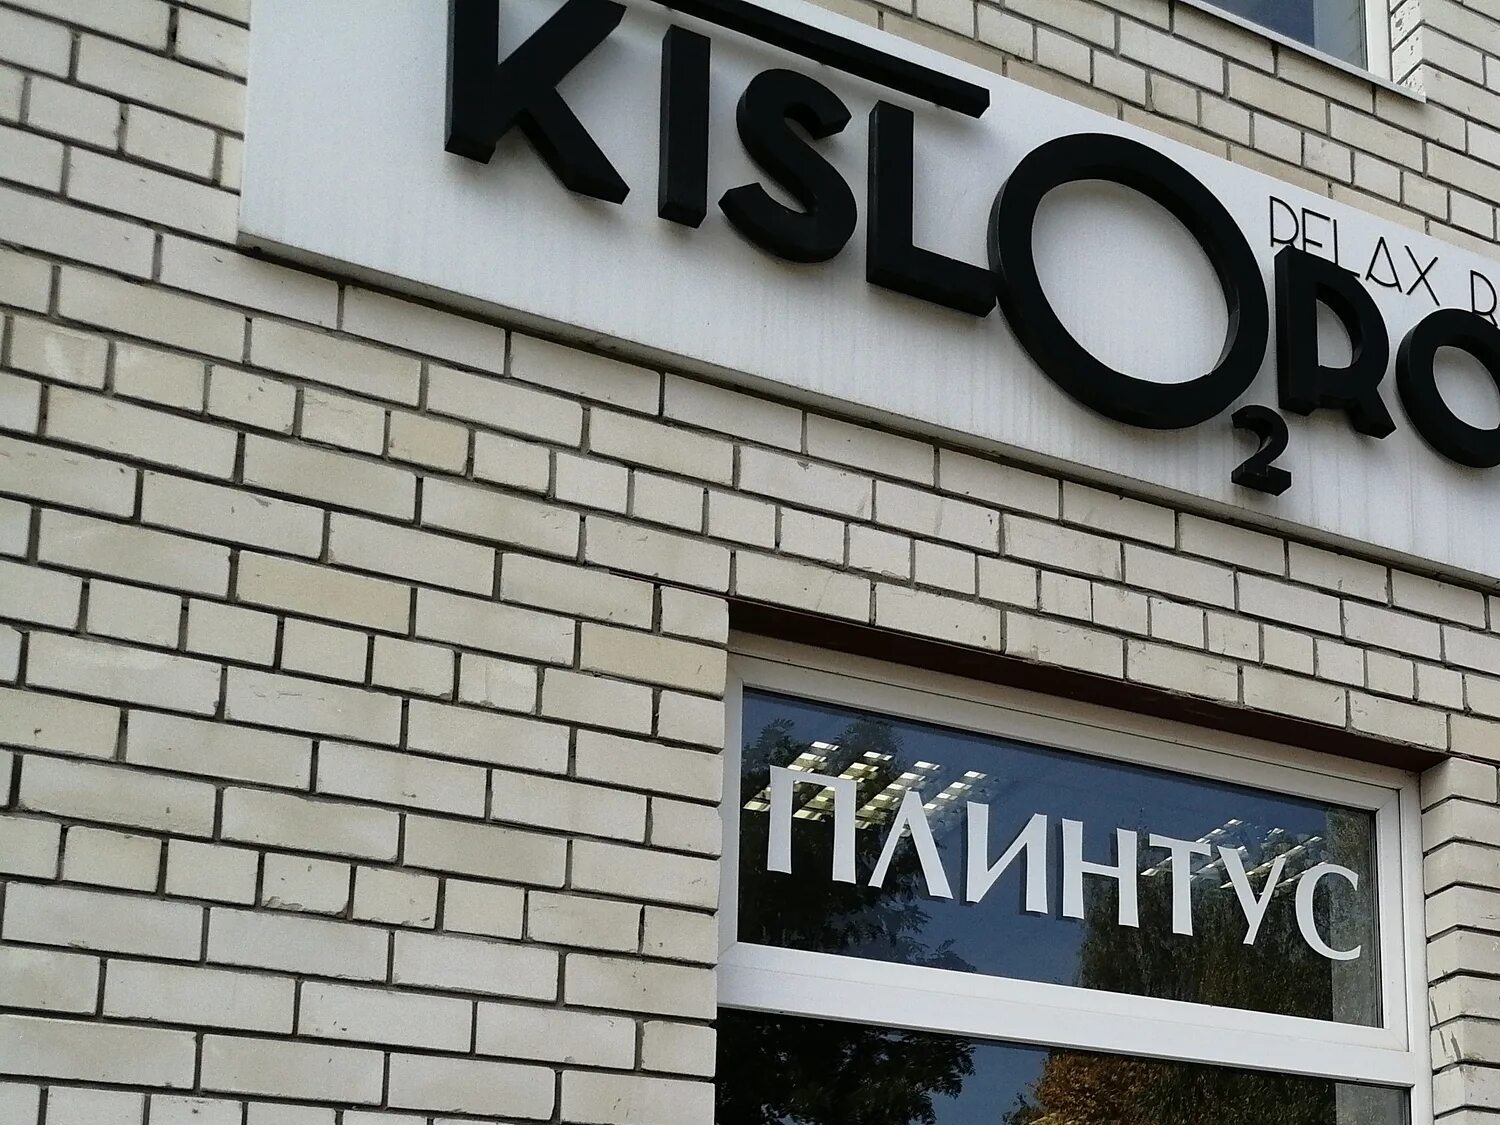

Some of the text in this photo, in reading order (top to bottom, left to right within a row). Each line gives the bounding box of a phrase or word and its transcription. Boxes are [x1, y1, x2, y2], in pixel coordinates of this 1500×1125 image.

[1269, 196, 1440, 306] RELAX
[1231, 404, 1292, 496] 2
[767, 765, 1361, 961] ПЛИНТУС
